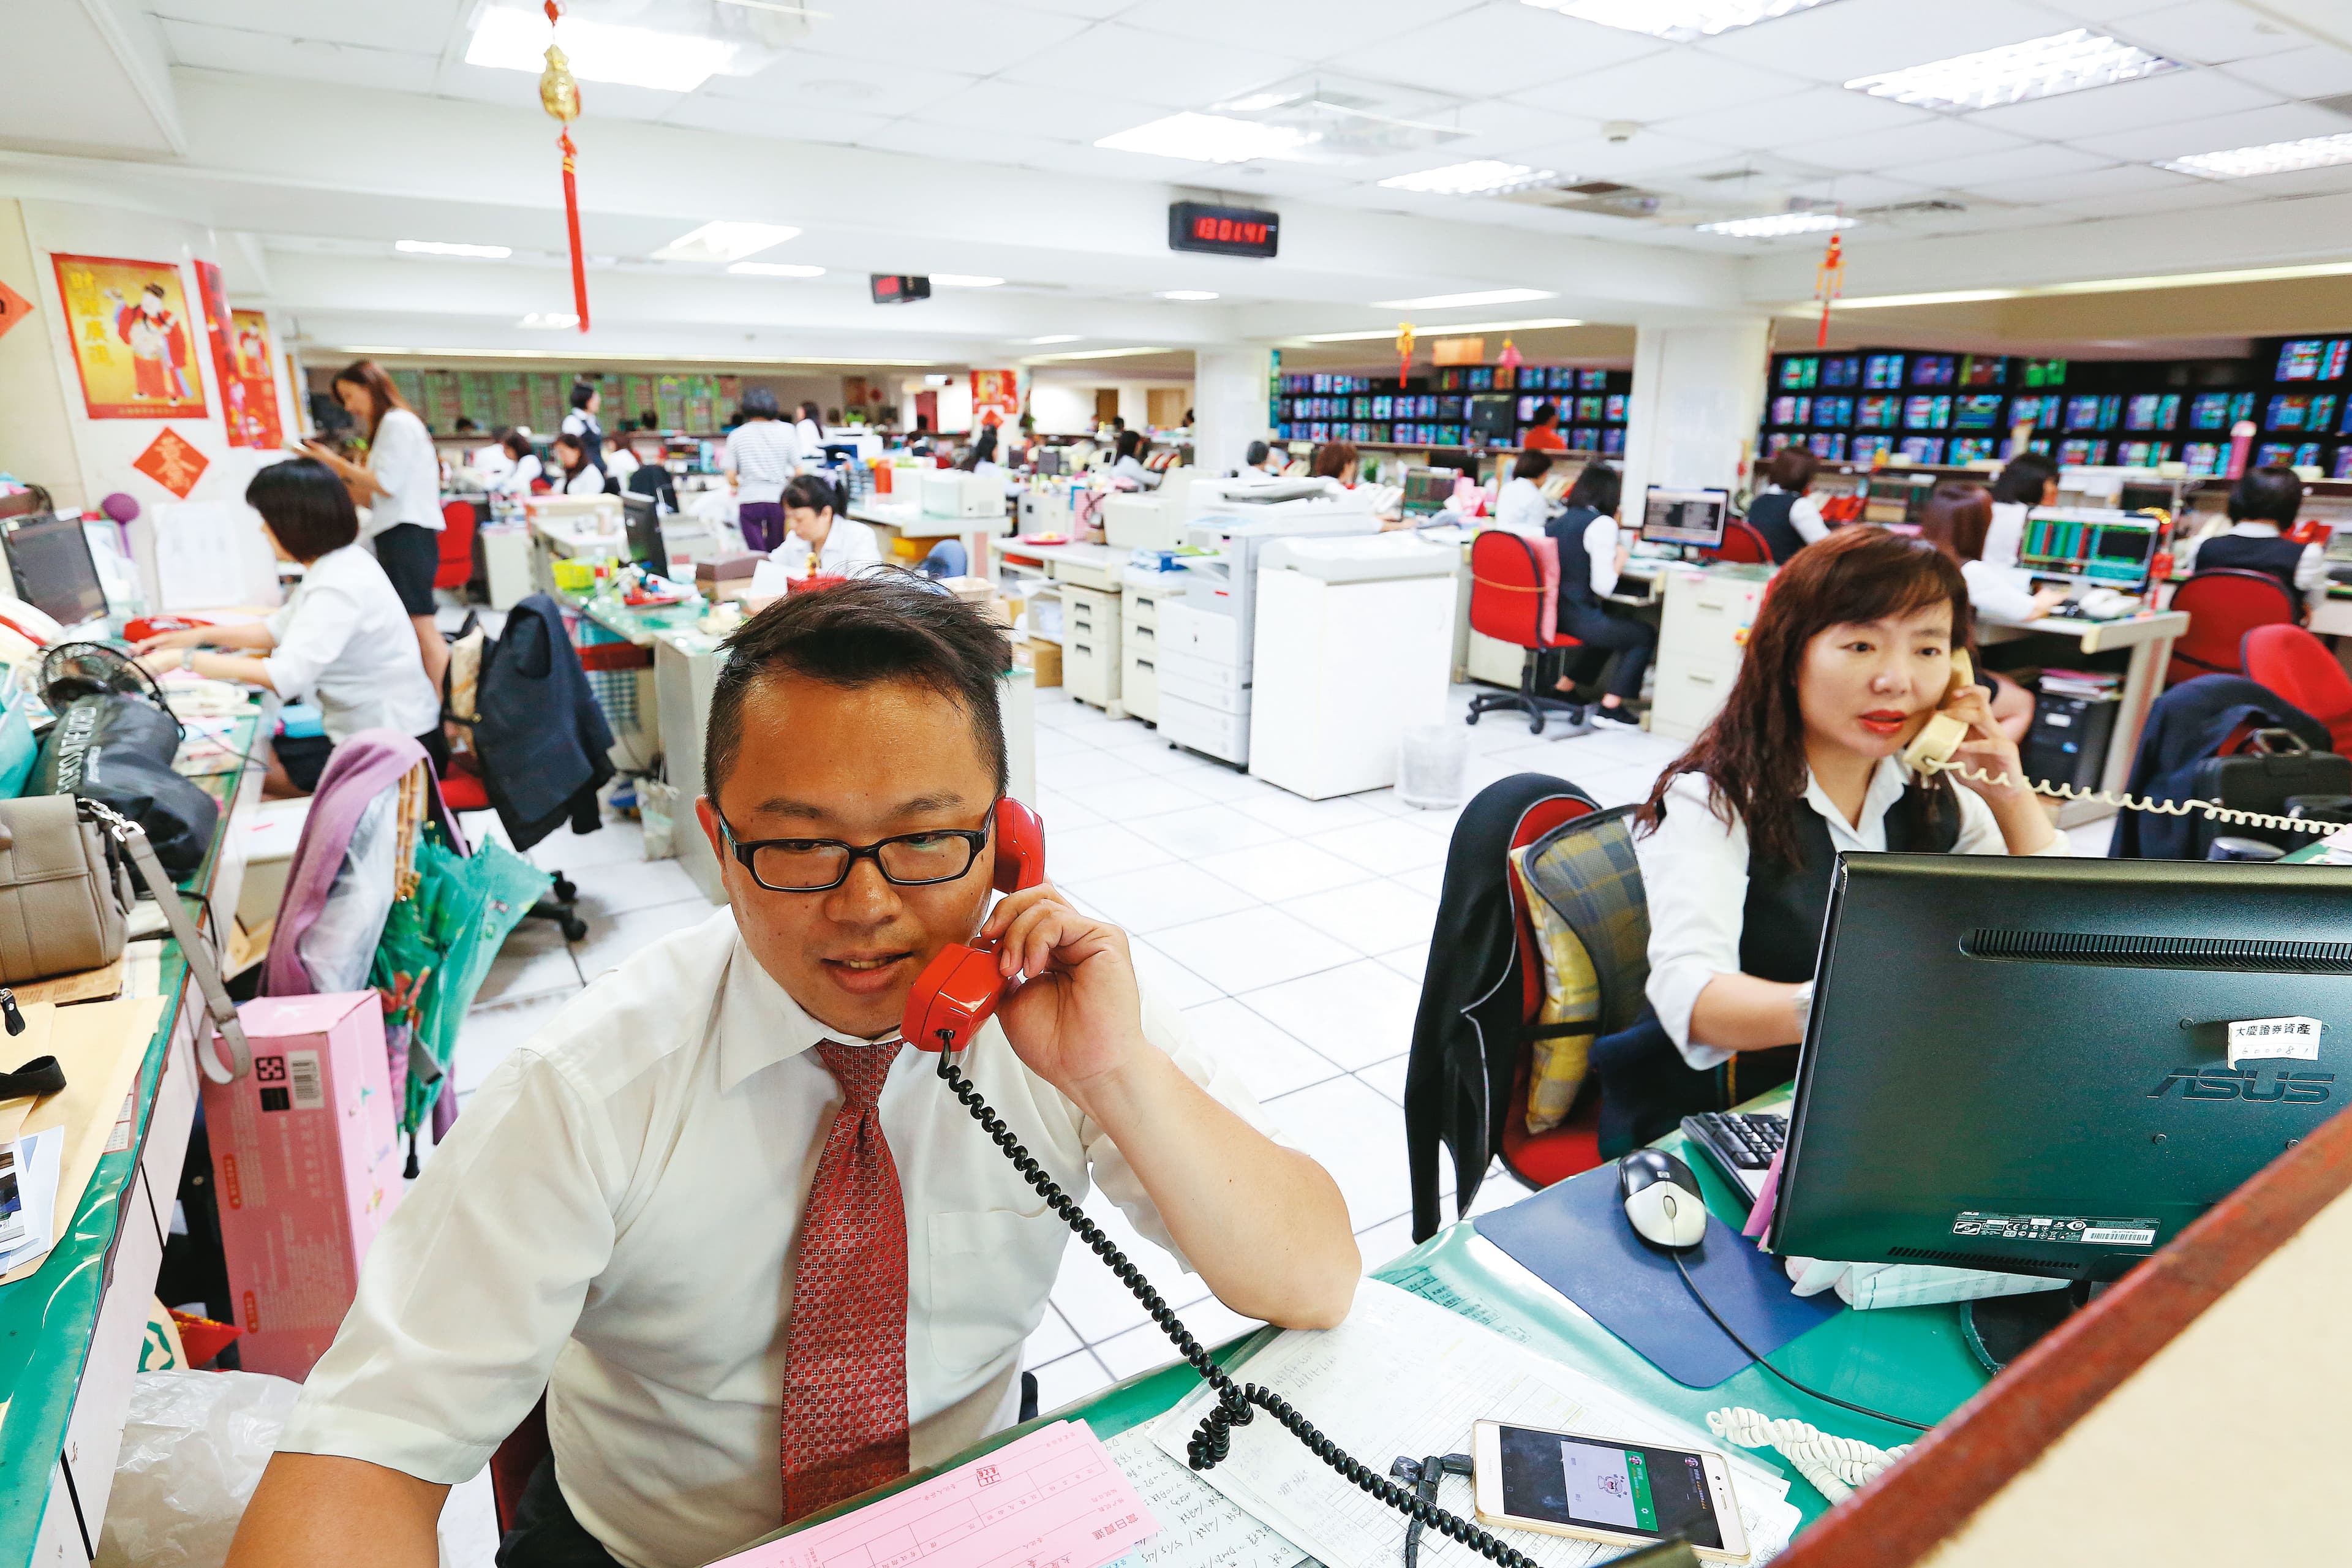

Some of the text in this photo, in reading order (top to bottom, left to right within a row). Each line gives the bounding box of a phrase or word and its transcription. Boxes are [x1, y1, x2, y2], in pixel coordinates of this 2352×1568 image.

[2235, 1023, 2312, 1036] 大慶證券資產
[2146, 1068, 2335, 1104] ASUS
[1091, 1513, 1138, 1539] 當日買進
